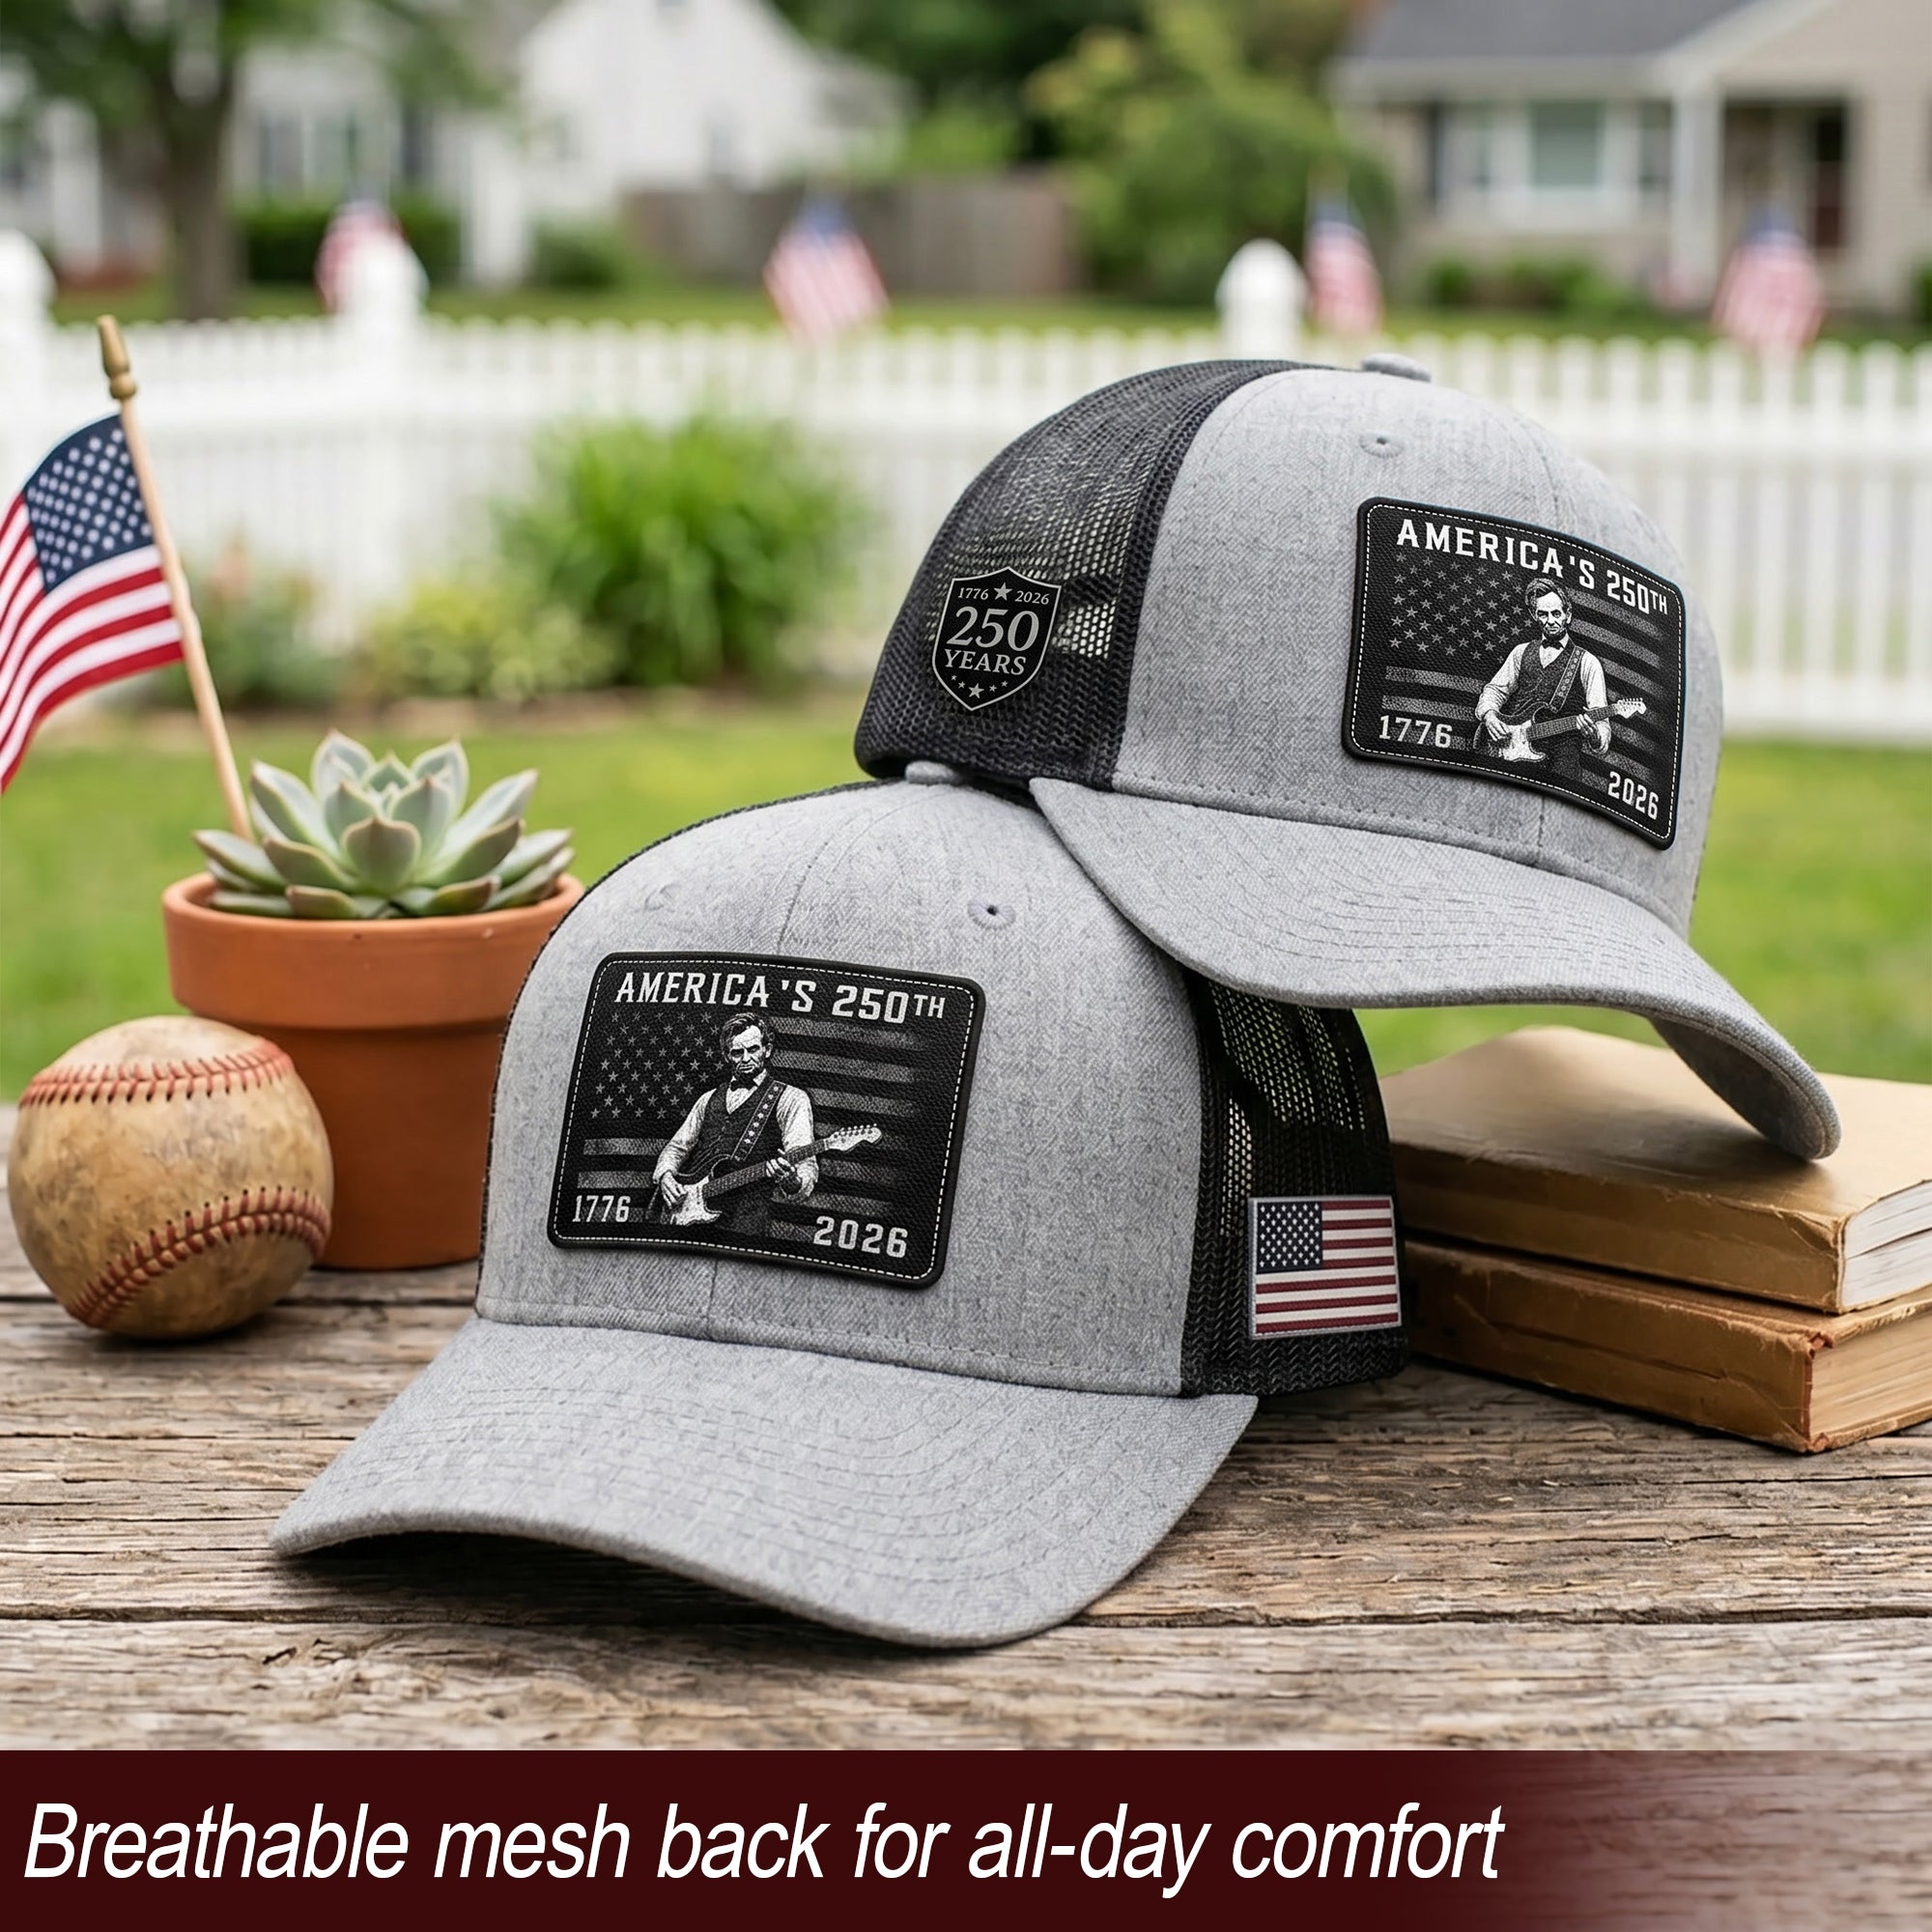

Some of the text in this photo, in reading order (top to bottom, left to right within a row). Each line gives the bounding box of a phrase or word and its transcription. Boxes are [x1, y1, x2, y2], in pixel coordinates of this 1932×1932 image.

[1397, 519, 1668, 616] AMERICA'S 250TH
[957, 587, 1050, 606] 1776 2026
[946, 606, 1039, 652] 250
[944, 648, 1027, 675] YEARS
[1378, 715, 1453, 749] 1776
[1607, 771, 1660, 820] 2026
[613, 972, 946, 1024] AMERICA'S 250TH
[572, 1194, 631, 1223] 1776
[812, 1215, 909, 1259] 2026
